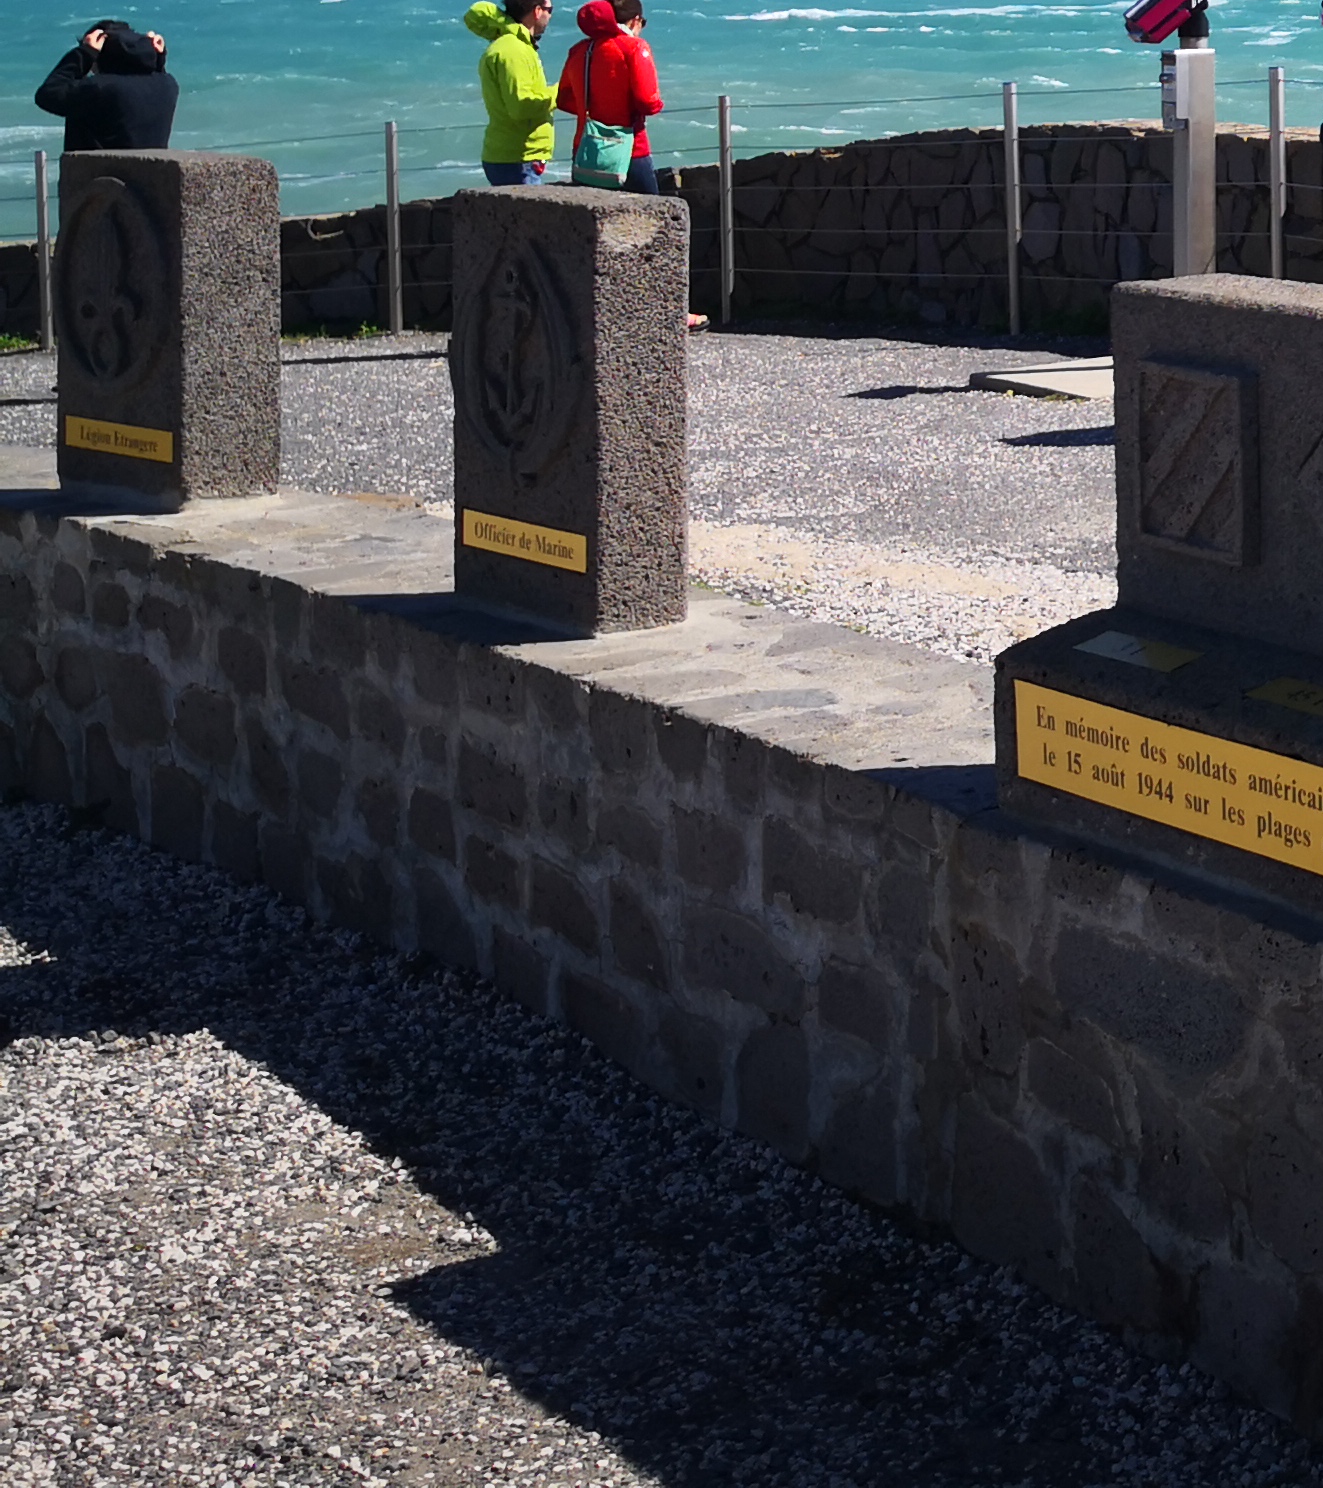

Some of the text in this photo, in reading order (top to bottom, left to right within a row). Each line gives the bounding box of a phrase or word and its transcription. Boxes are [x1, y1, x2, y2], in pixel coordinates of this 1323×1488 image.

[474, 521, 574, 560] Officier de Marine
[1037, 706, 1055, 730] En
[1066, 717, 1129, 754] mémoire
[1141, 737, 1166, 764] des
[1178, 752, 1236, 785] soldats
[1043, 742, 1056, 766] le
[1066, 750, 1082, 775] 15
[1093, 759, 1125, 788] août
[1137, 773, 1174, 804] 1944
[1185, 794, 1209, 815] sur
[1222, 798, 1245, 826] les
[1258, 812, 1311, 848] plages
